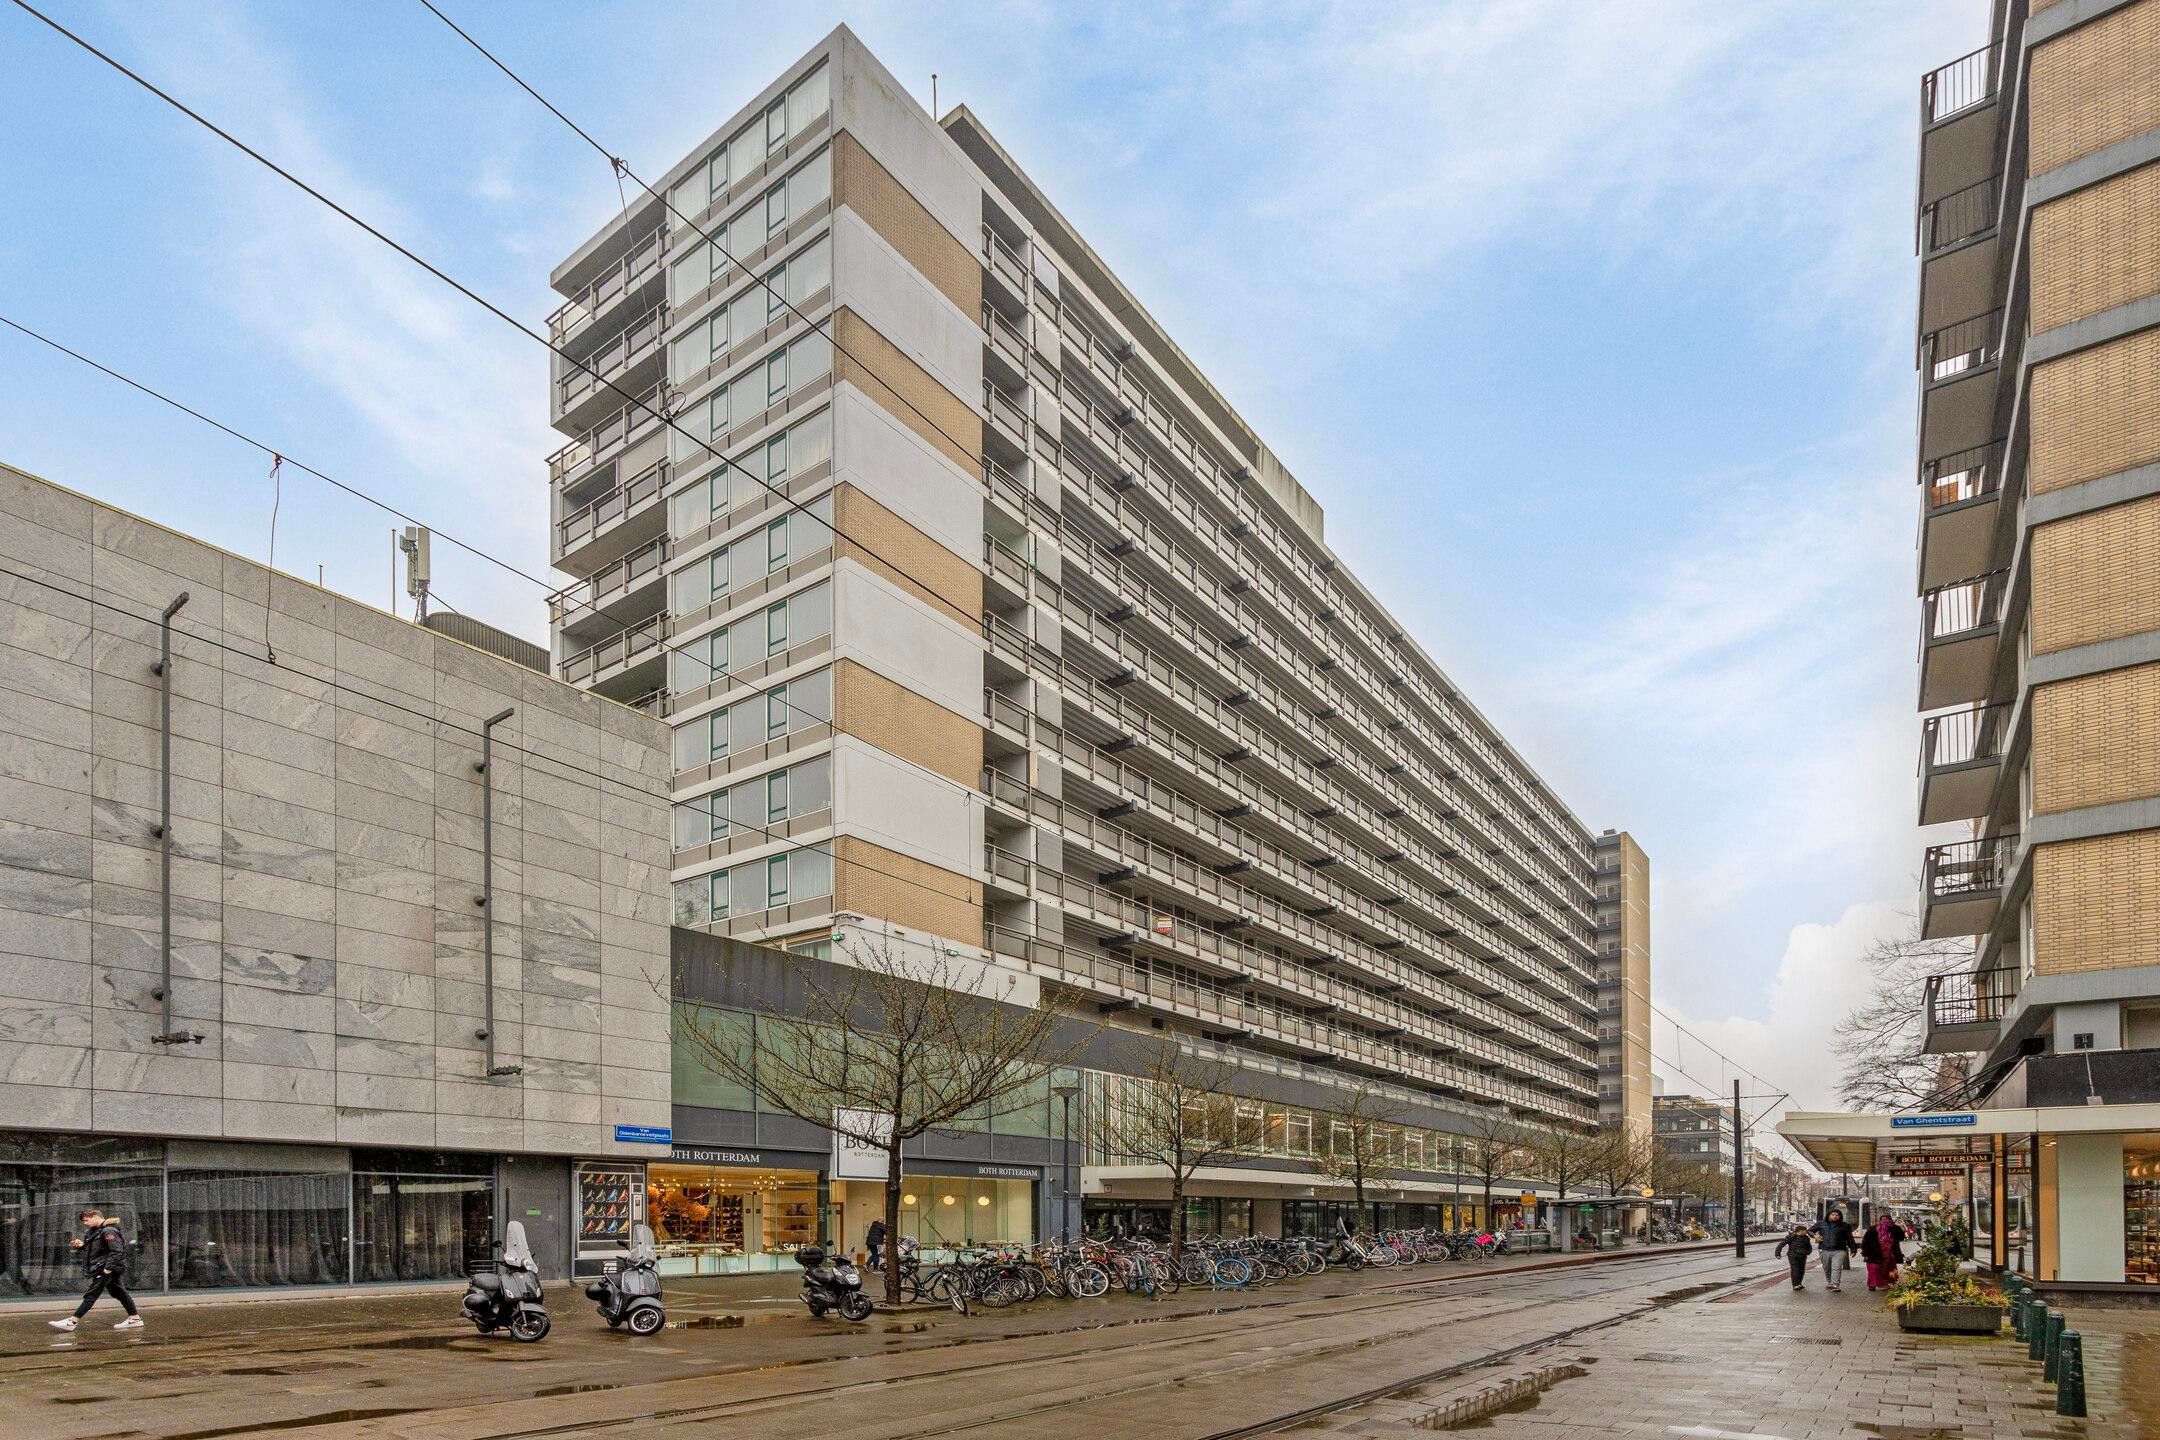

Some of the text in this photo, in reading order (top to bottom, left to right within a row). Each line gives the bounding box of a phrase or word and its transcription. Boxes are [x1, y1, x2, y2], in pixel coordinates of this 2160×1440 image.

[1916, 1116, 1971, 1124] Ghentstraat
[671, 1149, 760, 1163] TH ROTTERDAM
[1901, 1154, 1988, 1164] BOTH ROTTERDAM
[978, 1166, 1038, 1177] BOTH ROTTERDAM
